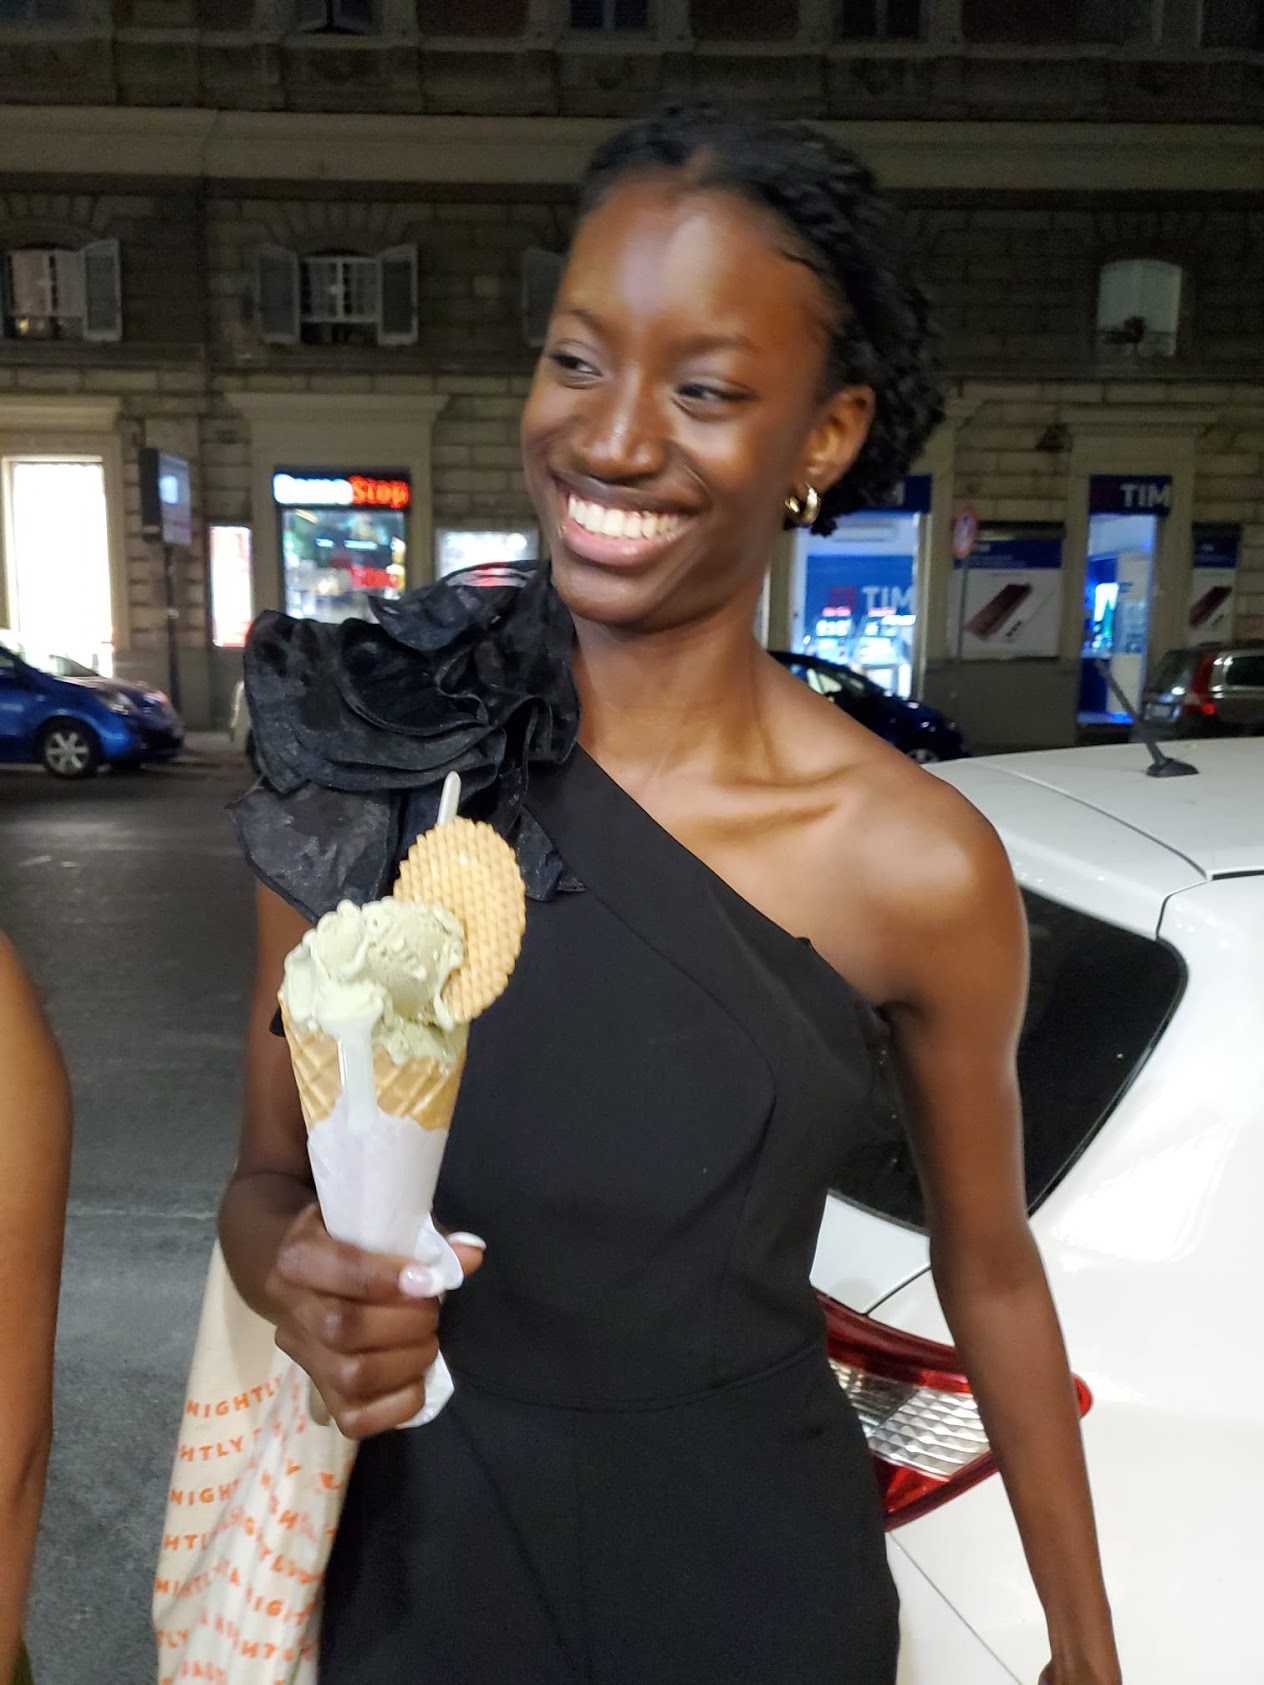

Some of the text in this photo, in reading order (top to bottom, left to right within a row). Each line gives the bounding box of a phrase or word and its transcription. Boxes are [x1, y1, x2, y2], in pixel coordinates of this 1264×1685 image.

[273, 473, 410, 509] Stop
[1120, 483, 1171, 508] TIM
[861, 585, 913, 611] TIM
